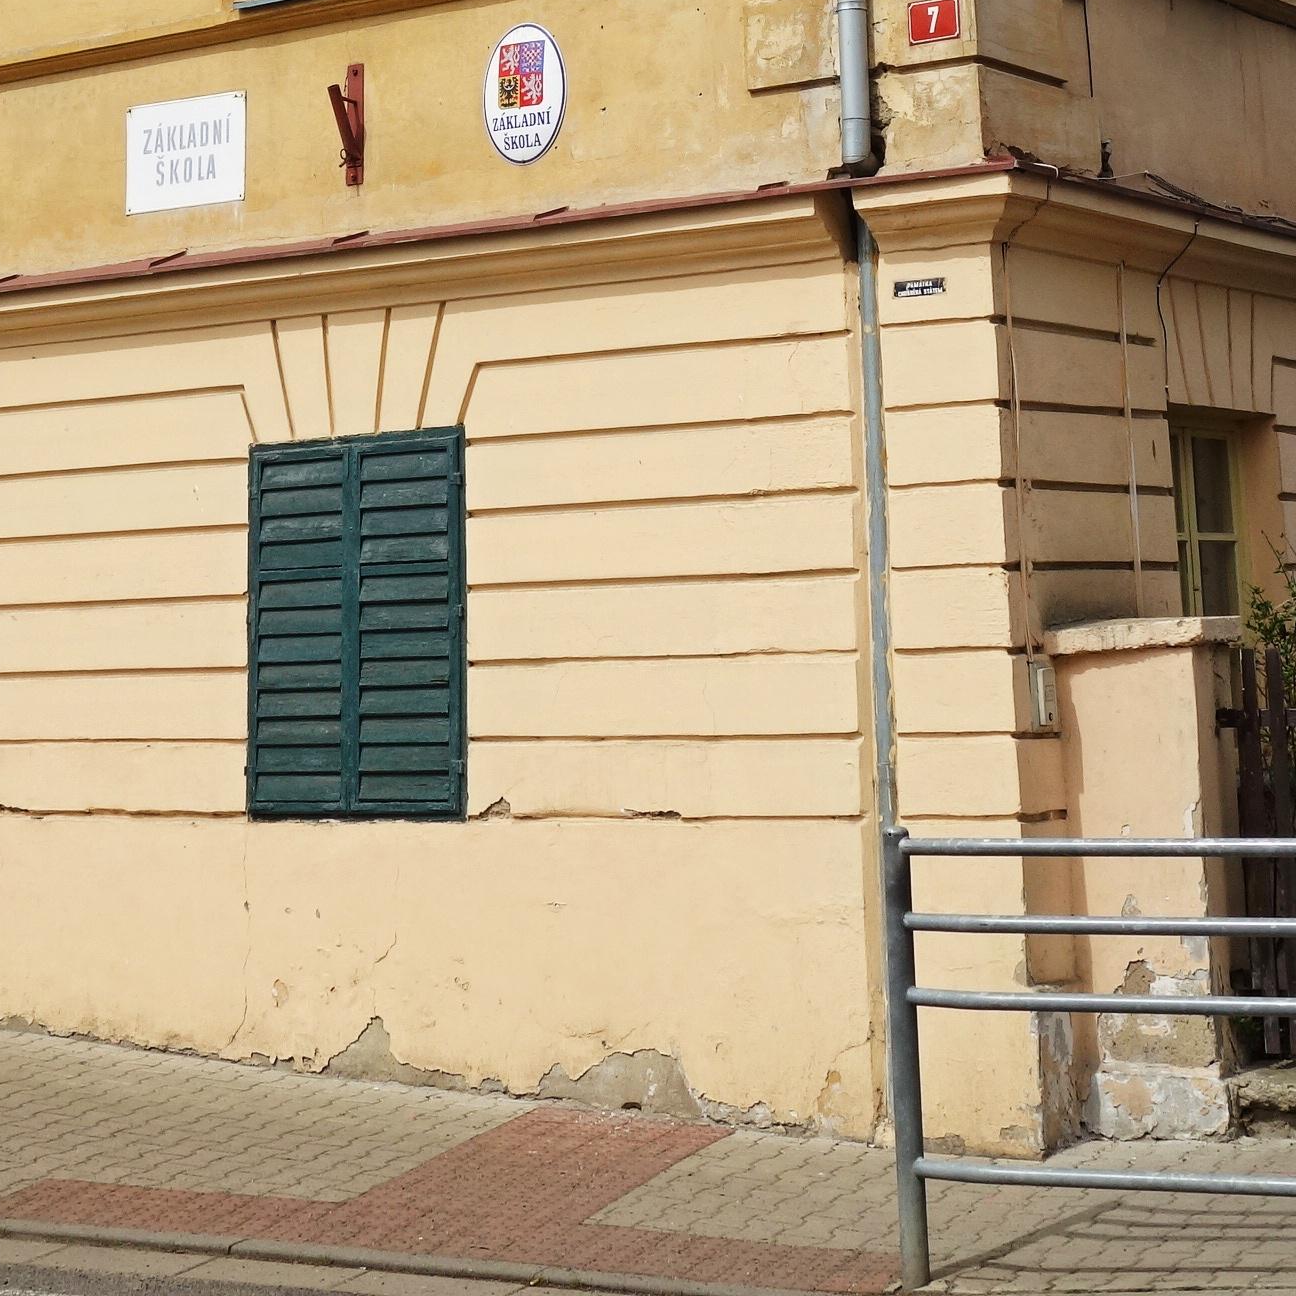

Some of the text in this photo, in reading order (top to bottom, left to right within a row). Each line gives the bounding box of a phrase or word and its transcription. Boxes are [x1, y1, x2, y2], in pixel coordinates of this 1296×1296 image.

[927, 5, 939, 34] 7
[142, 112, 232, 155] ZÁKLADNÍ
[492, 106, 552, 132] ZÁKLADNÍ
[504, 133, 542, 151] ŠKOLA
[155, 154, 217, 187] ŠKOLA
